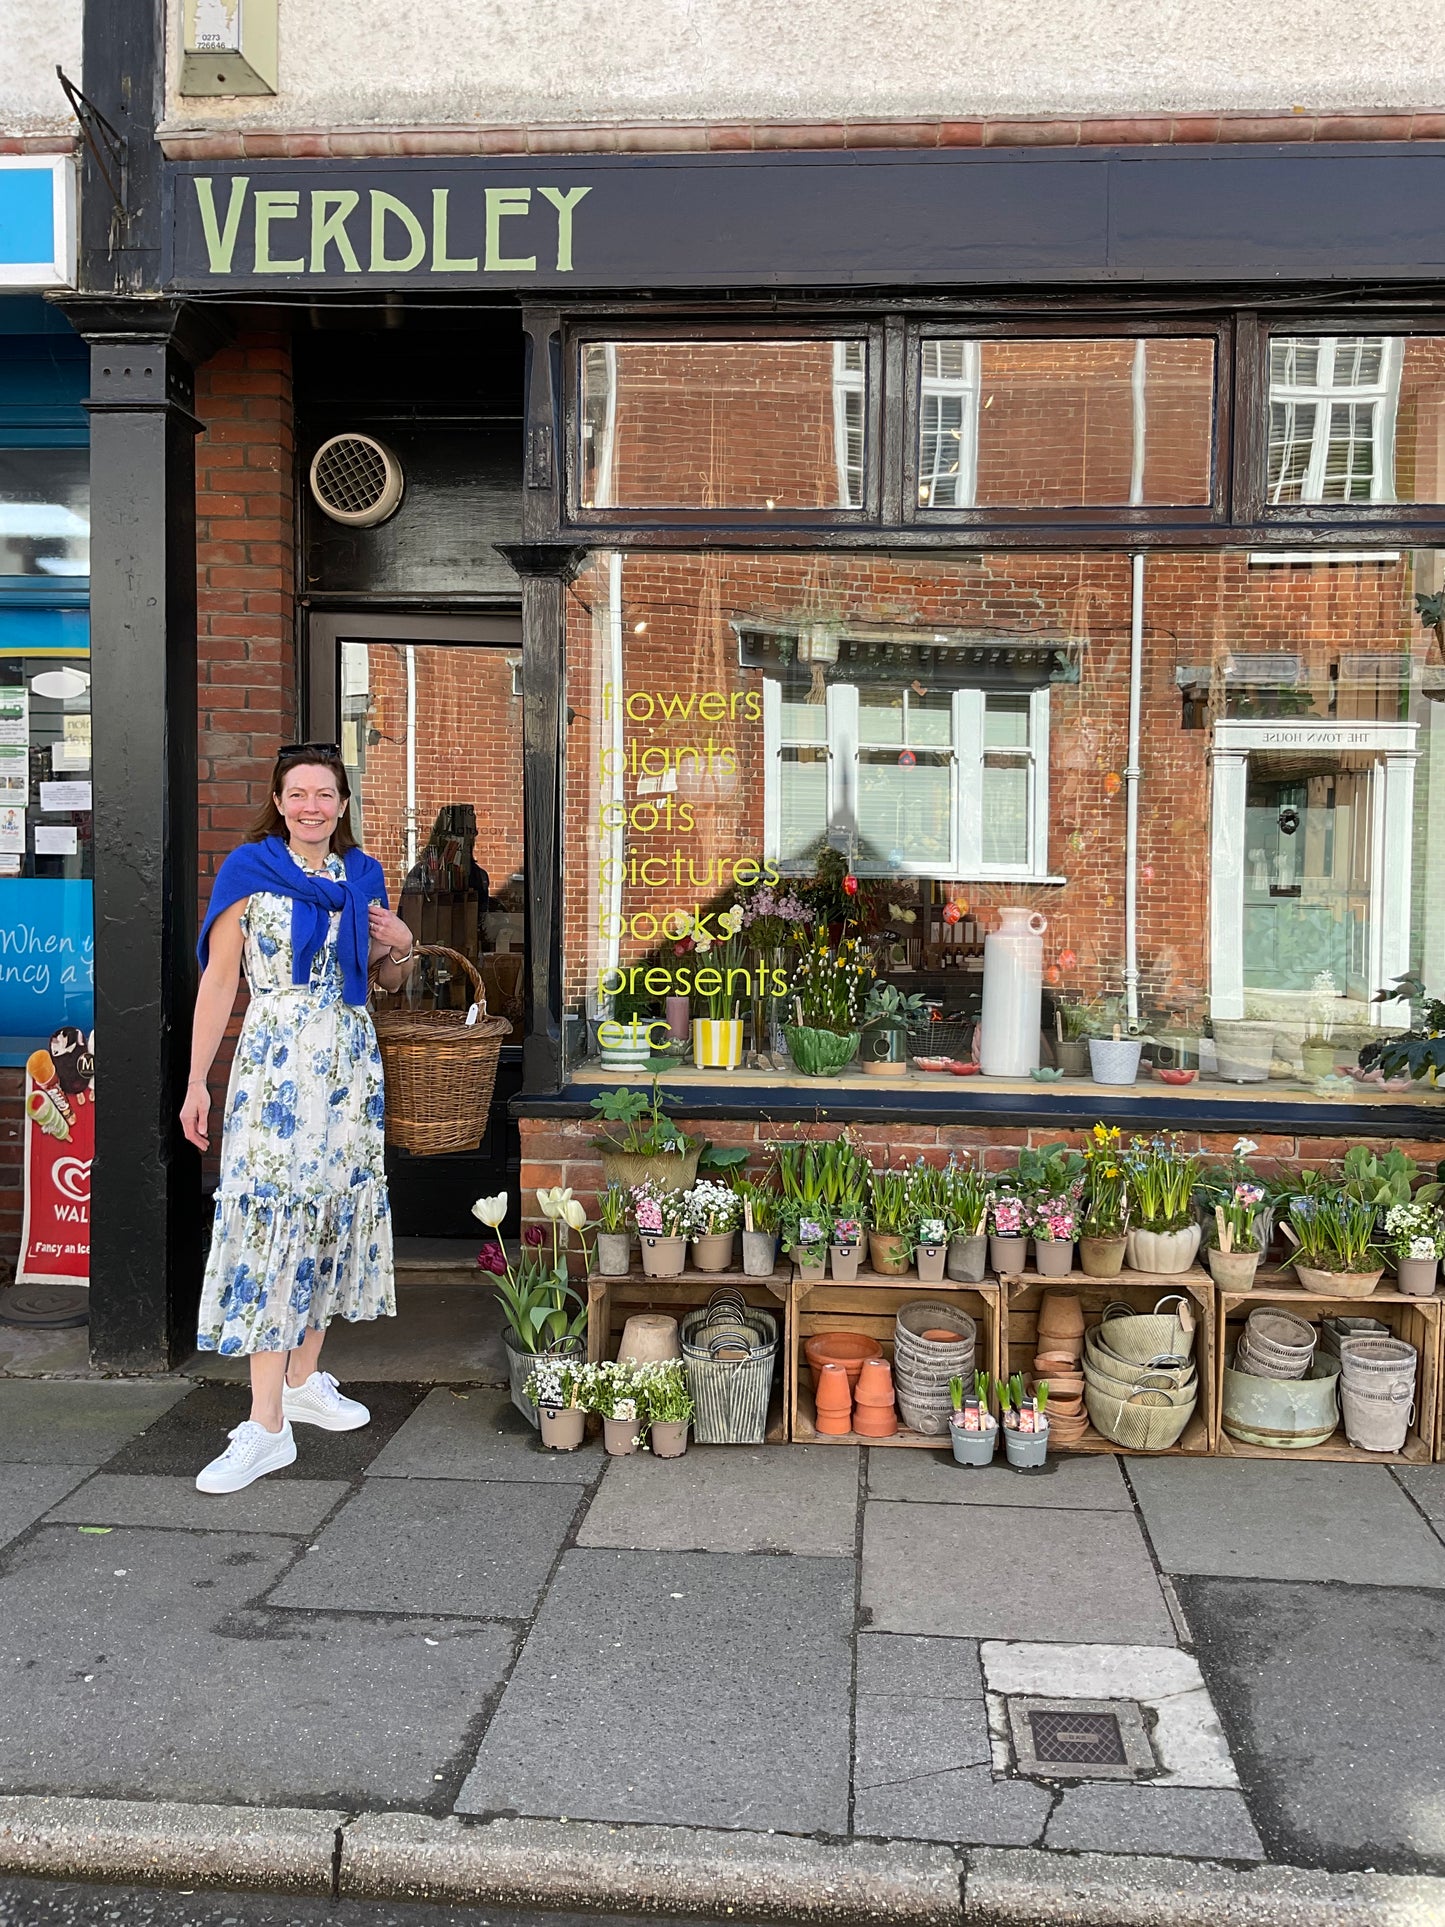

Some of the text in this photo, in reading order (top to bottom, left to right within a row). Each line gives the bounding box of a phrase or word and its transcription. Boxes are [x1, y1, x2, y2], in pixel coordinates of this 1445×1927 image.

[193, 176, 593, 273] VERDLEY
[602, 681, 761, 721] flowers
[600, 738, 736, 785] plants
[599, 794, 695, 840] pots
[599, 848, 780, 895] pictures
[0, 923, 75, 954] When
[599, 903, 733, 941] books
[60, 965, 77, 984] a
[598, 960, 788, 1003] presents
[598, 1012, 672, 1049] etc
[35, 1242, 63, 1257] Fancy
[64, 1244, 76, 1254] an
